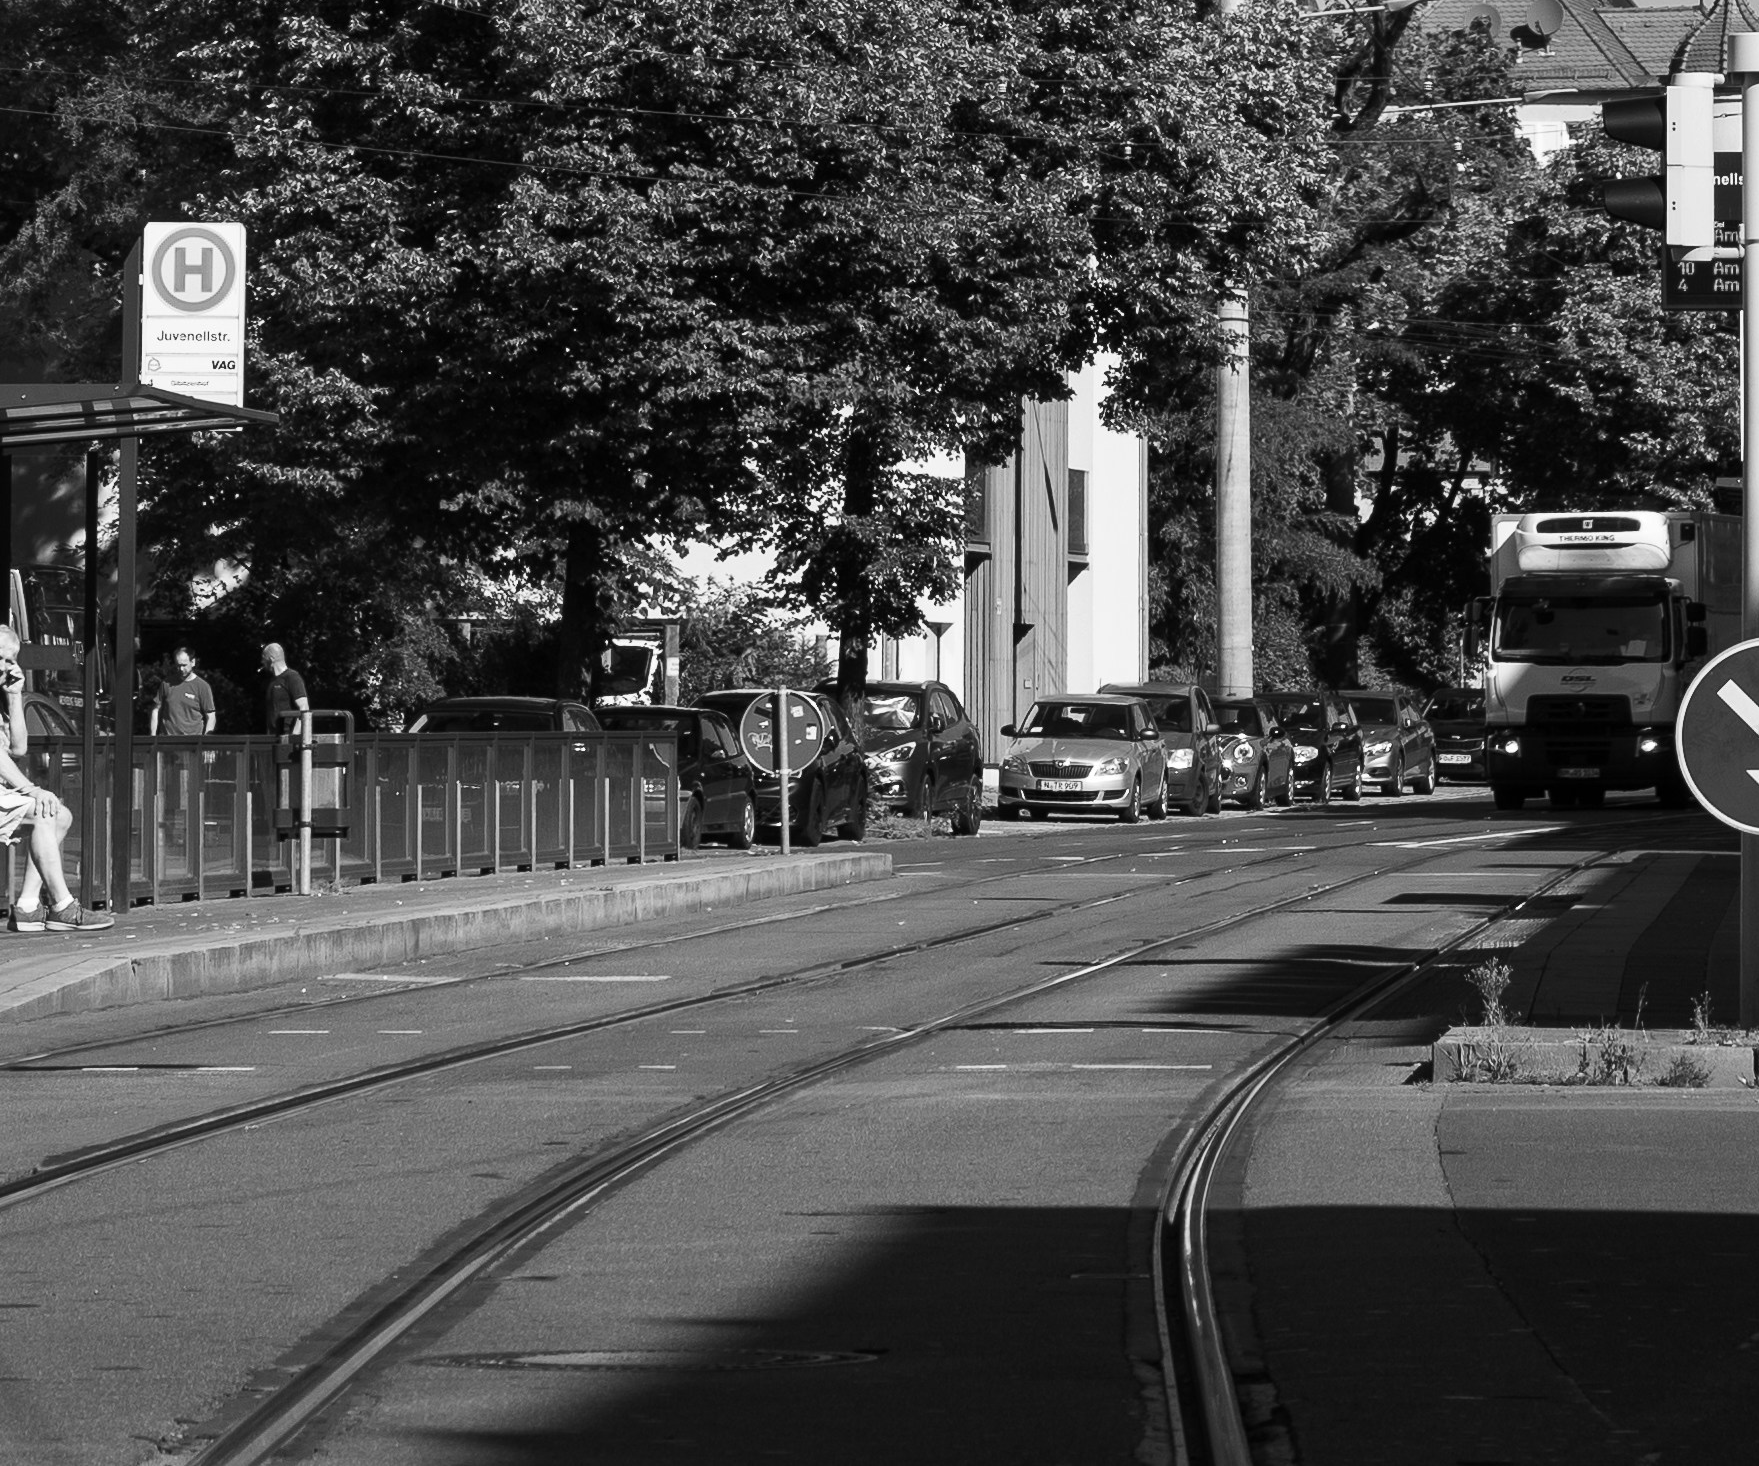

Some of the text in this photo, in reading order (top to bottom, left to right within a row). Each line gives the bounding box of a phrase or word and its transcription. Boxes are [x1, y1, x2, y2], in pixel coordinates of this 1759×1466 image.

[174, 247, 213, 293] H
[1678, 261, 1695, 276] 10
[1713, 261, 1740, 275] Am
[1678, 278, 1689, 292] 4
[1713, 278, 1740, 291] Am
[157, 330, 231, 342] Juvenellstr.
[211, 360, 236, 370] VAG
[1559, 534, 1616, 542] THERMO KING
